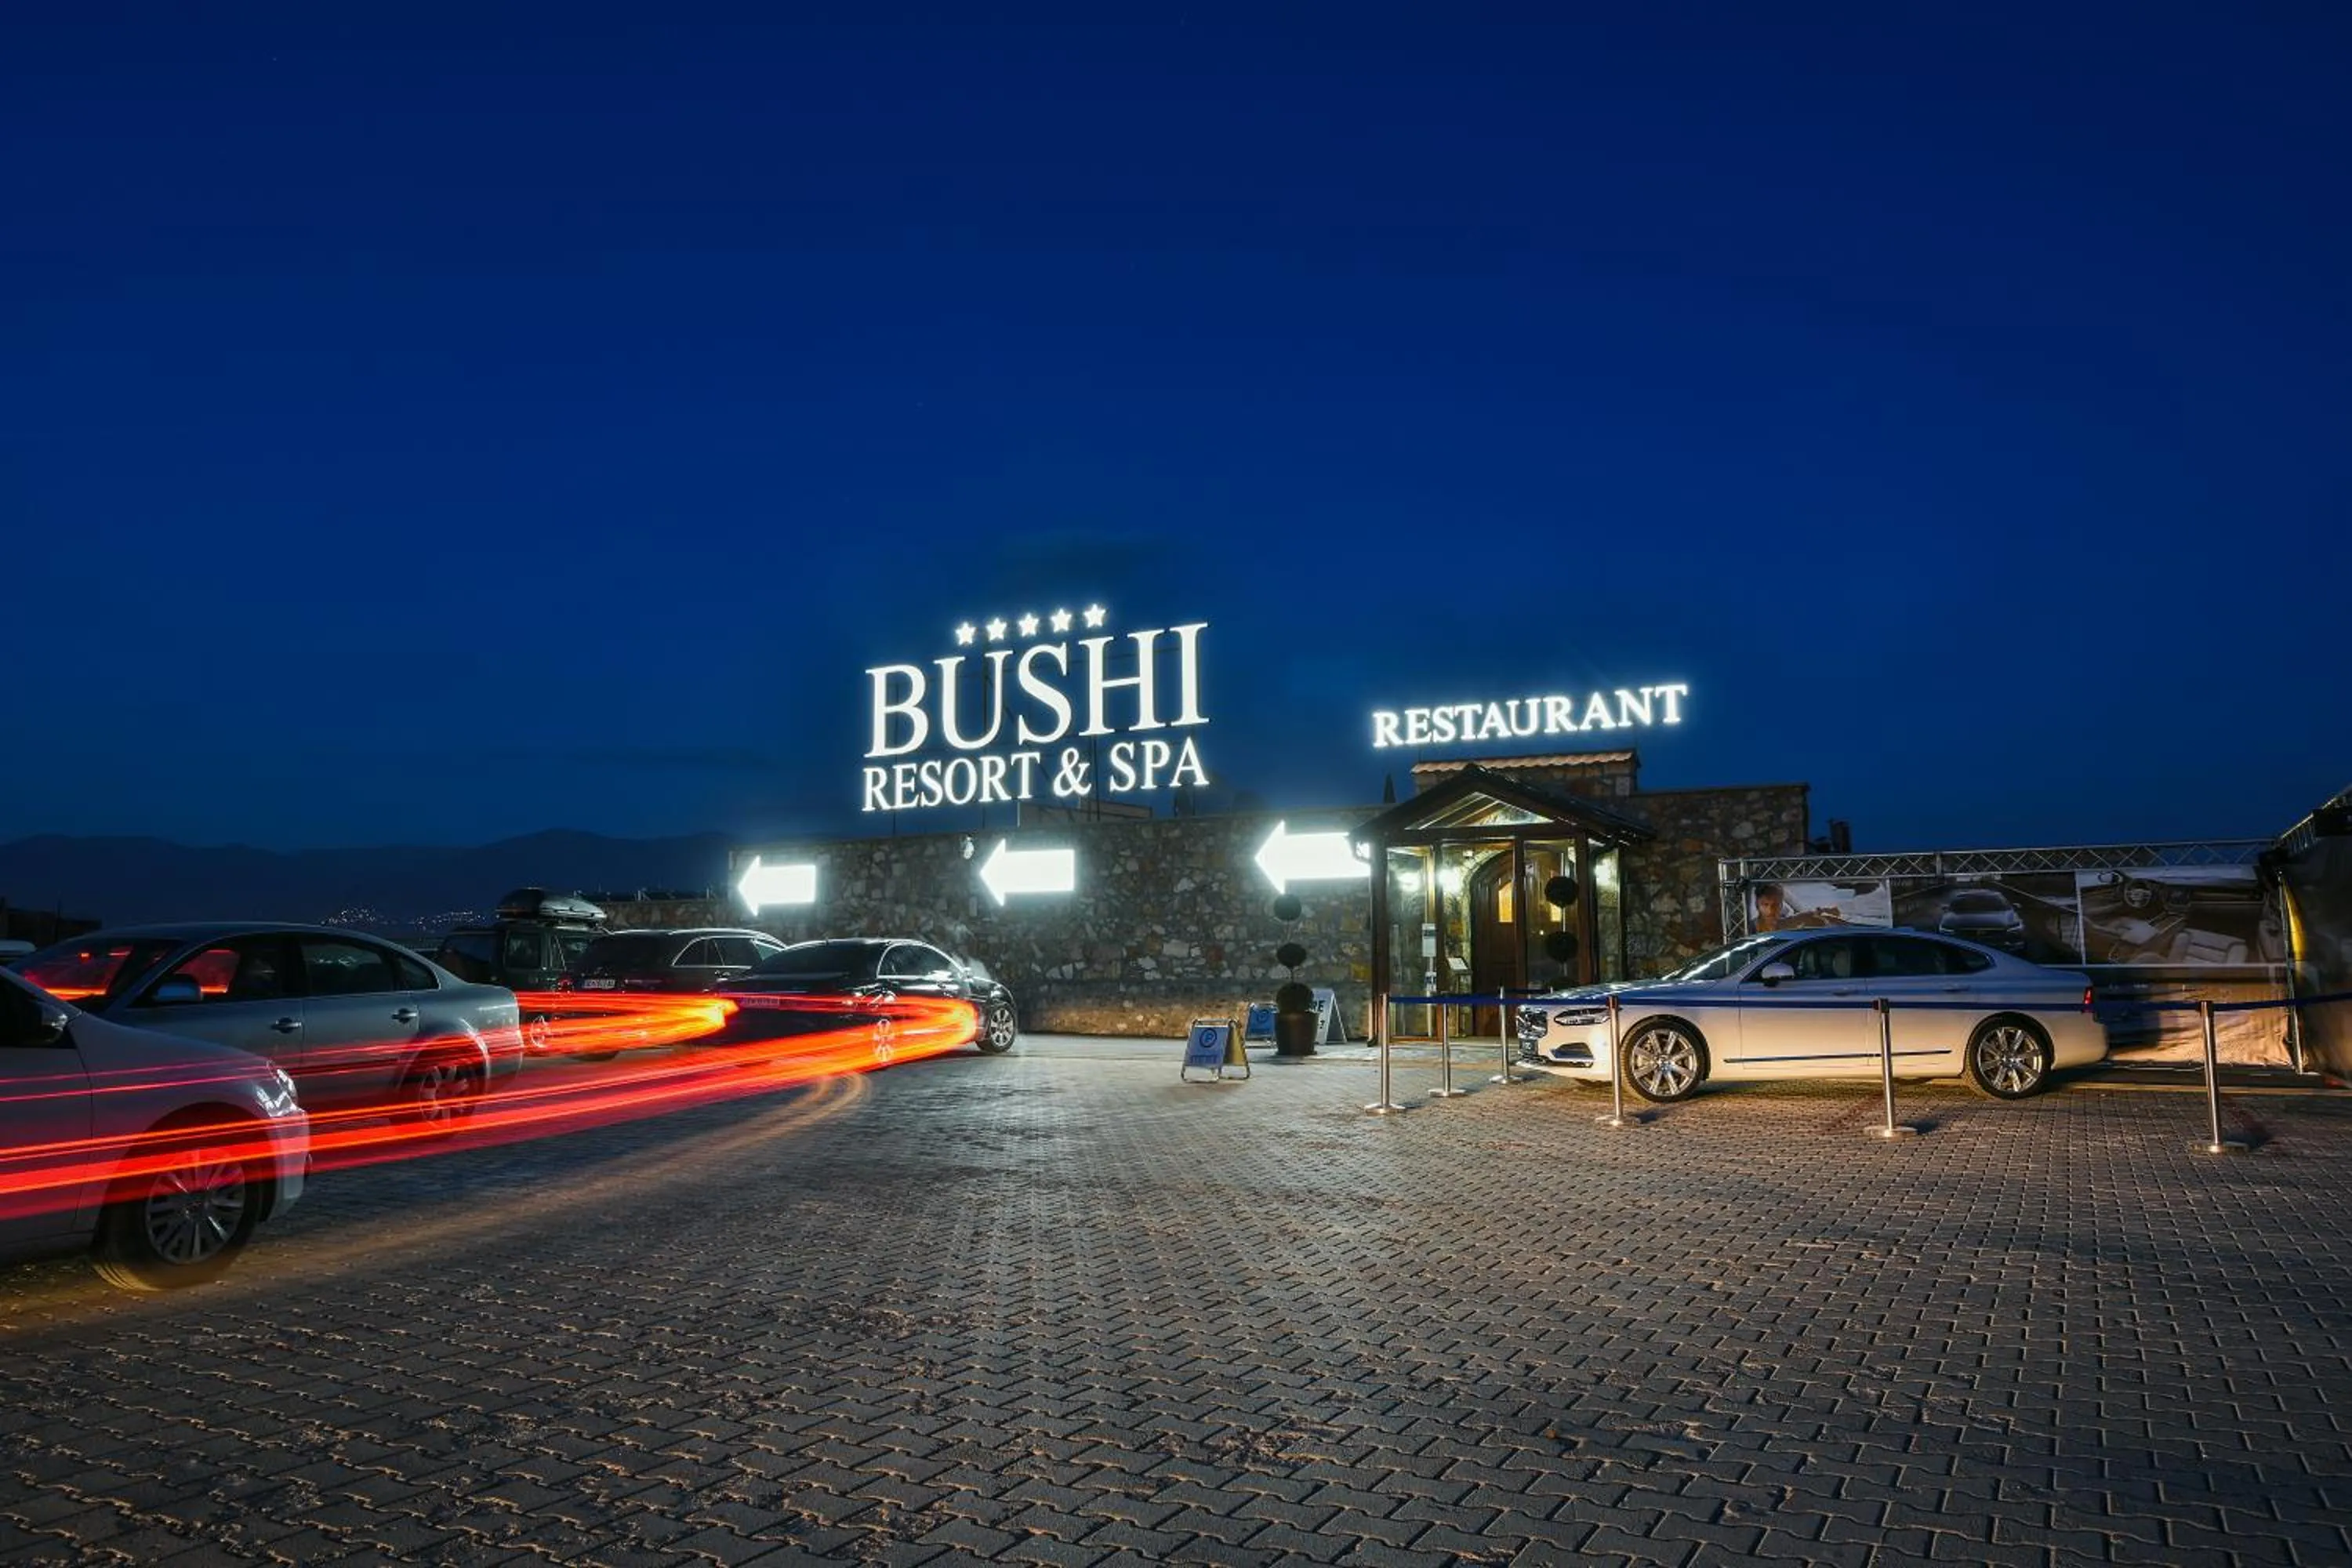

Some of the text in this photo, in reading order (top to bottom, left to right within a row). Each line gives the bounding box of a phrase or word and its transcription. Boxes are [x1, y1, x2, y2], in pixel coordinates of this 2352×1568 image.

[864, 622, 1210, 758] BUSHI
[1372, 684, 1688, 748] RESTAURANT
[862, 735, 1210, 811] RESORT & SPA
